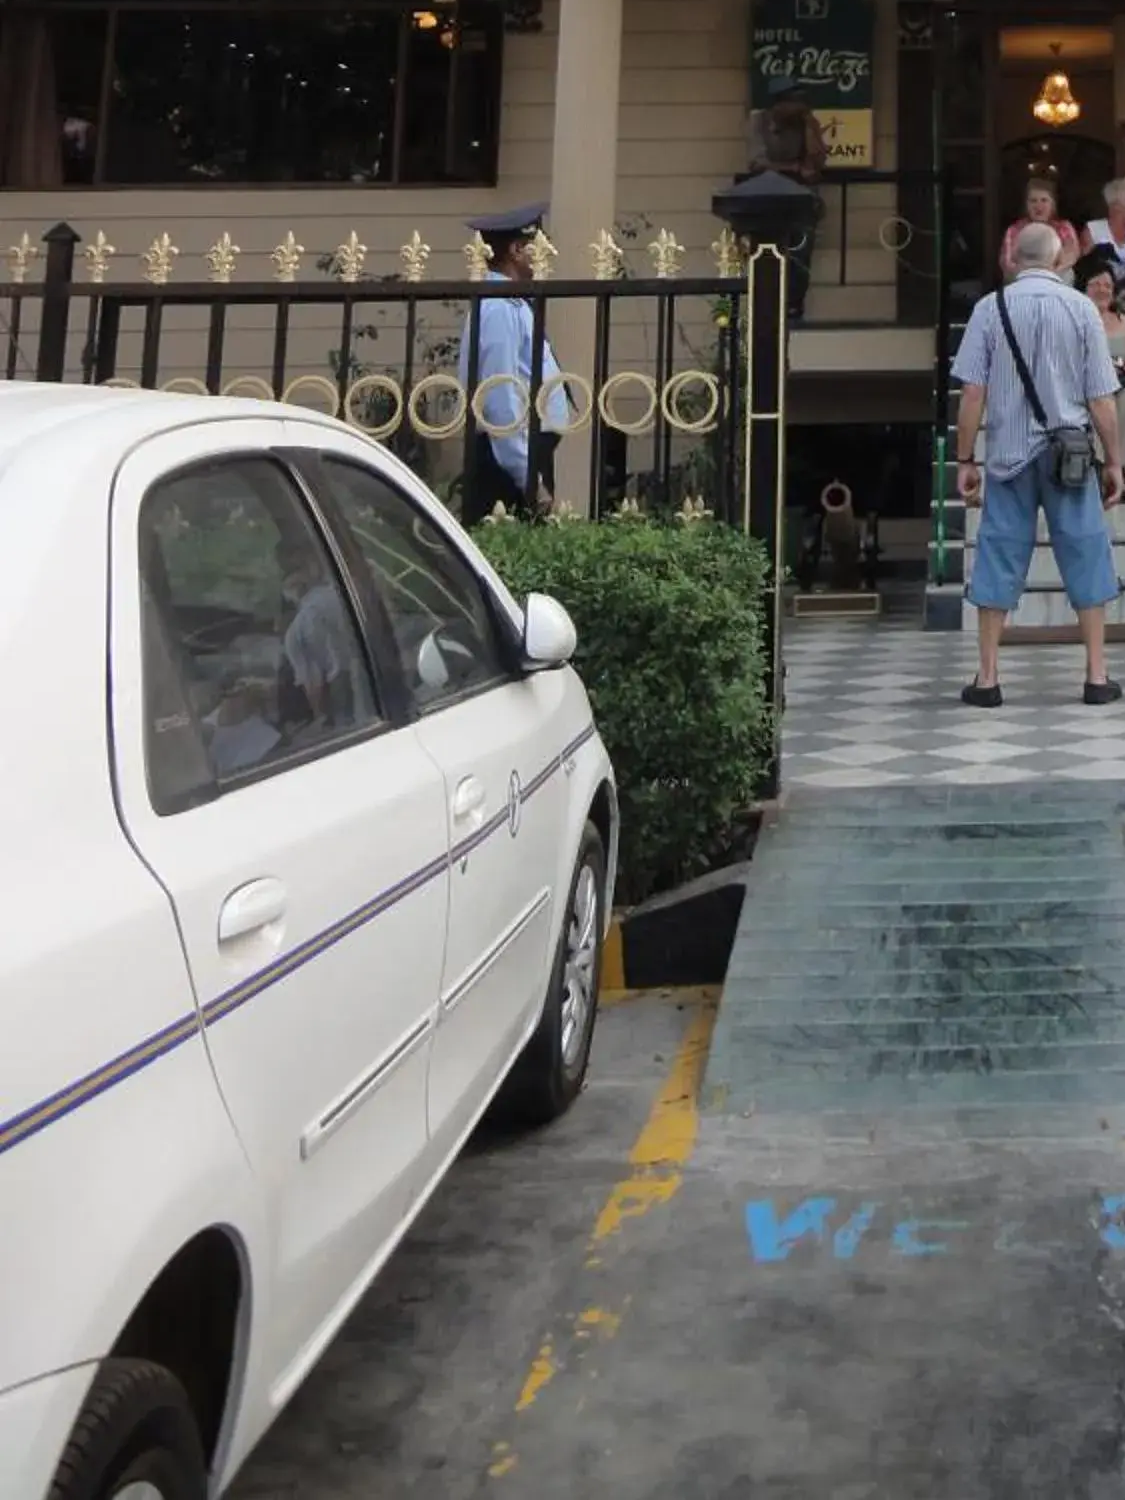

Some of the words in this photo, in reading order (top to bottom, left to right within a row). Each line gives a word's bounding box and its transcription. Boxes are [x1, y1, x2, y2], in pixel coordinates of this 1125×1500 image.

[754, 28, 803, 42] HOTEL
[753, 45, 796, 77] Taj
[800, 47, 871, 92] Plaza
